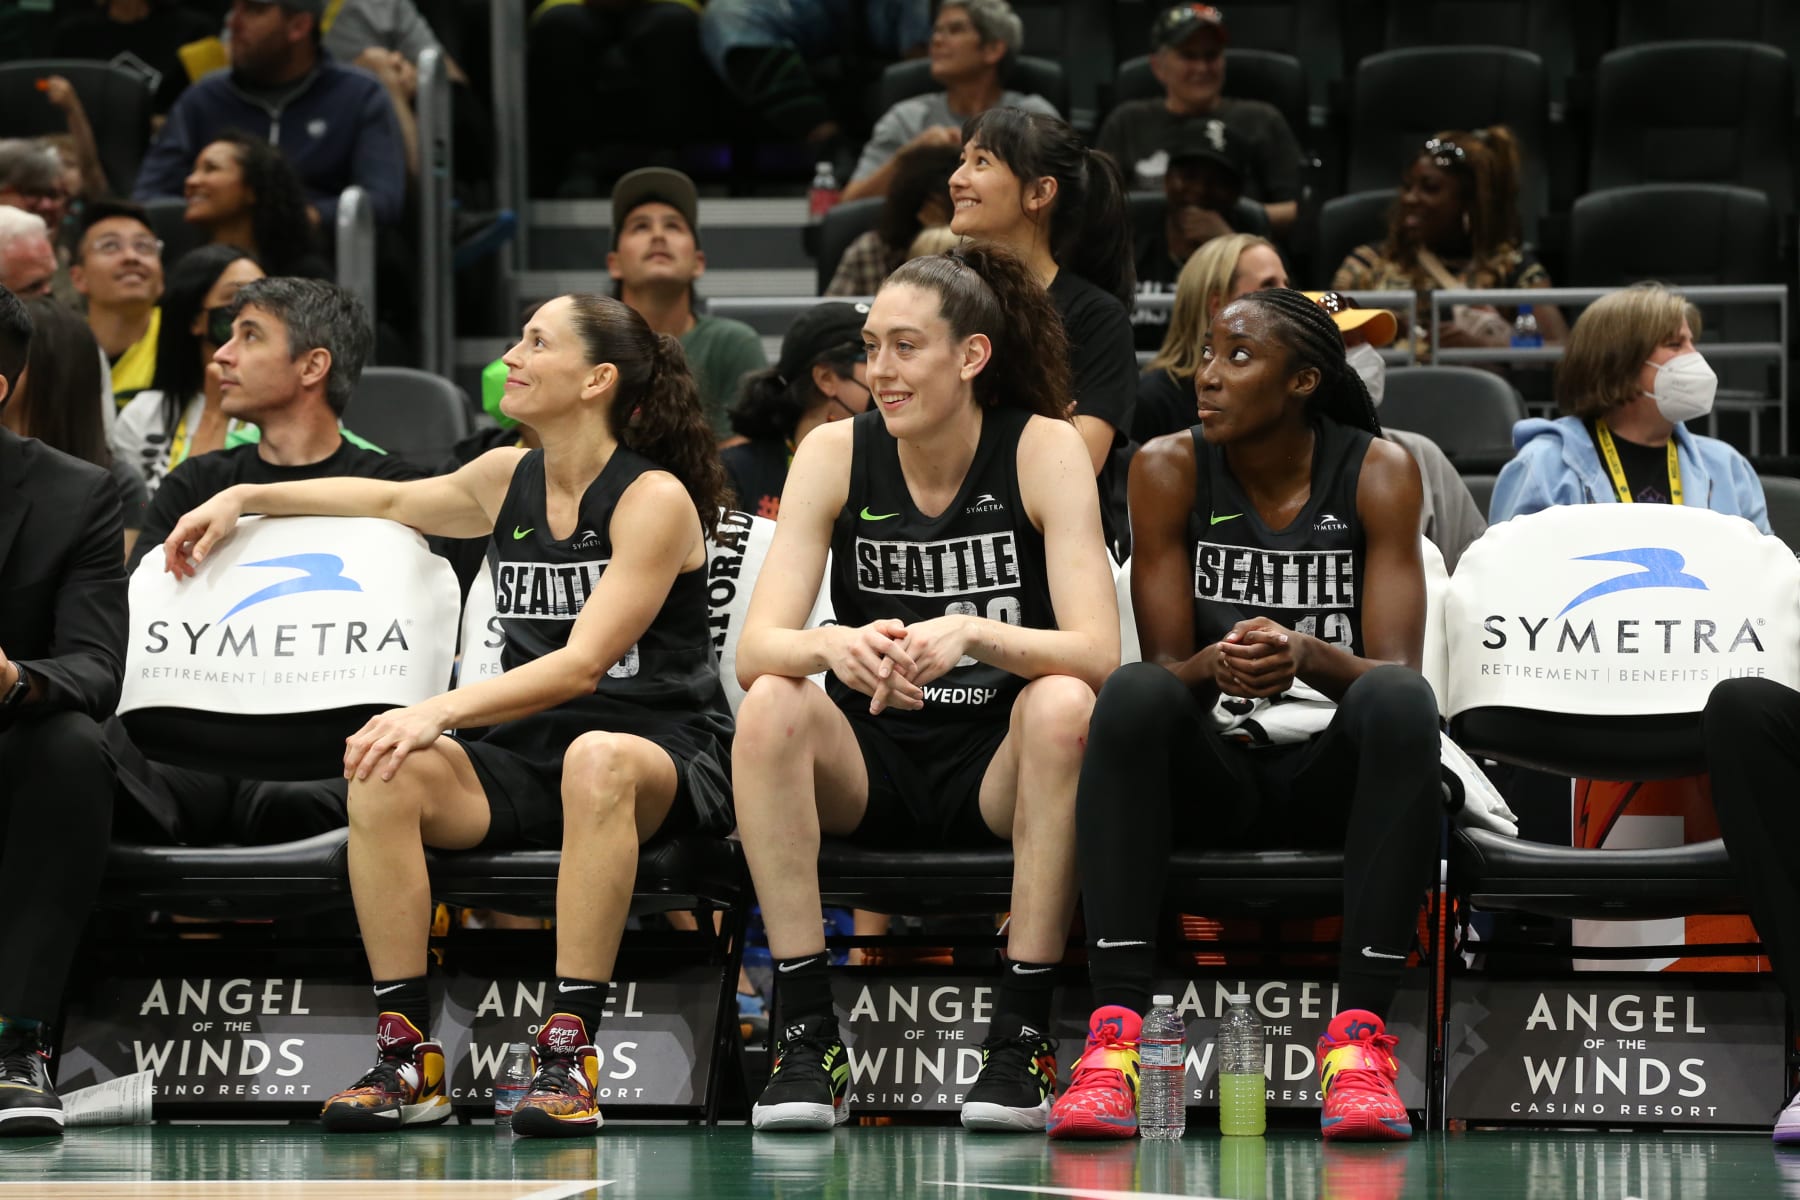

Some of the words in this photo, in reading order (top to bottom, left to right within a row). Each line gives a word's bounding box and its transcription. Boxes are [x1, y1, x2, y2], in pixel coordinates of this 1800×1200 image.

[966, 504, 1004, 514] SYMETRA
[858, 535, 1017, 593] SEATTLE
[1198, 547, 1353, 605] SEATTLE
[145, 618, 410, 657] SYMETRA
[1482, 614, 1765, 654] SYMETRA
[141, 666, 256, 684] RETIREMENT
[273, 668, 356, 684] BENEFITS
[373, 664, 408, 677] LIFE
[1481, 663, 1600, 682] RETIREMENT
[1618, 668, 1709, 682] BENEFITS
[920, 686, 997, 705] WEDISH
[139, 978, 310, 1016] ANGEL
[476, 980, 643, 1017] ANEL
[849, 985, 993, 1023] ANGE
[192, 1022, 214, 1032] OF
[224, 1021, 252, 1032] THE
[1525, 992, 1706, 1033] ANGEL
[904, 1030, 925, 1040] OF
[936, 1030, 964, 1040] THE
[1264, 1025, 1292, 1036] THE
[1583, 1039, 1605, 1049] OF
[1616, 1039, 1646, 1050] THE
[133, 1039, 305, 1078] WINDS
[846, 1048, 983, 1085] WIND
[152, 1085, 205, 1095] SINO
[219, 1085, 311, 1095] RESORT
[1523, 1055, 1707, 1097] WINDS
[849, 1093, 922, 1103] ASINO
[1510, 1102, 1605, 1114] CASINO
[1620, 1104, 1717, 1117] RESORT
